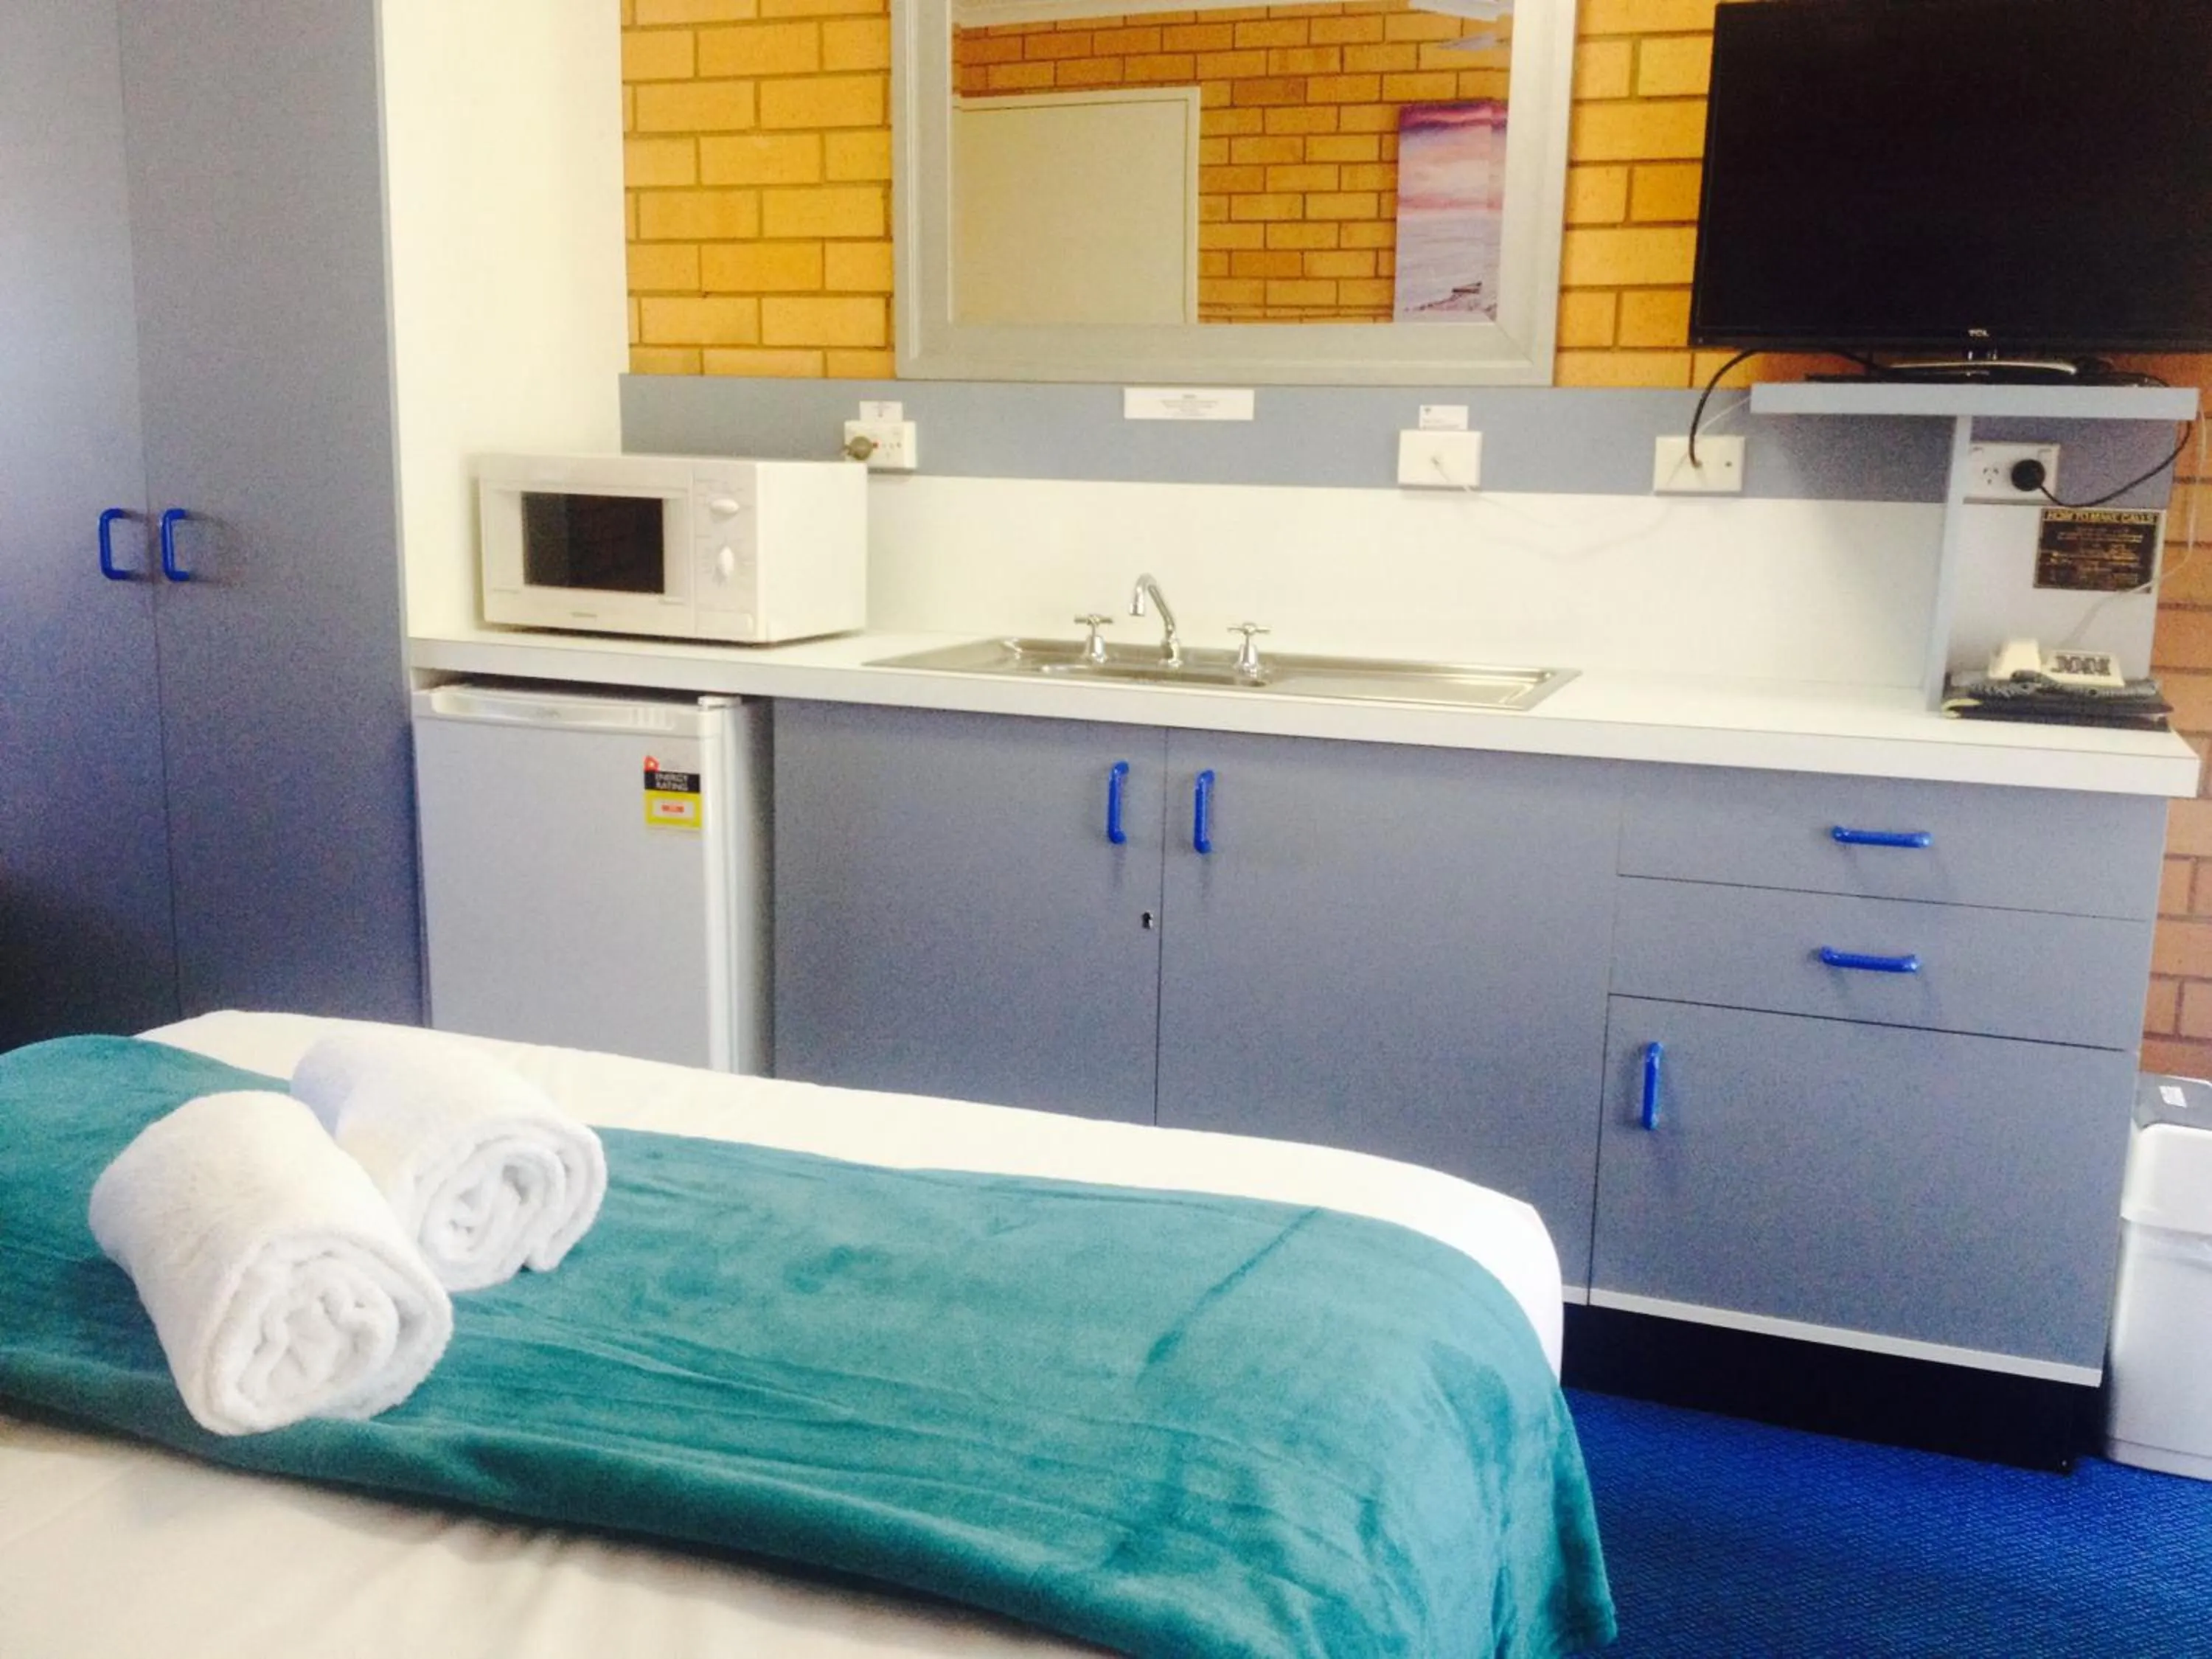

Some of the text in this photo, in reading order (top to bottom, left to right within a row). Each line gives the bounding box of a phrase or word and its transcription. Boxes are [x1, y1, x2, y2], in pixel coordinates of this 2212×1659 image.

[1968, 329, 1989, 338] TCL
[655, 773, 687, 783] ENERGY
[655, 782, 688, 791] RATING
